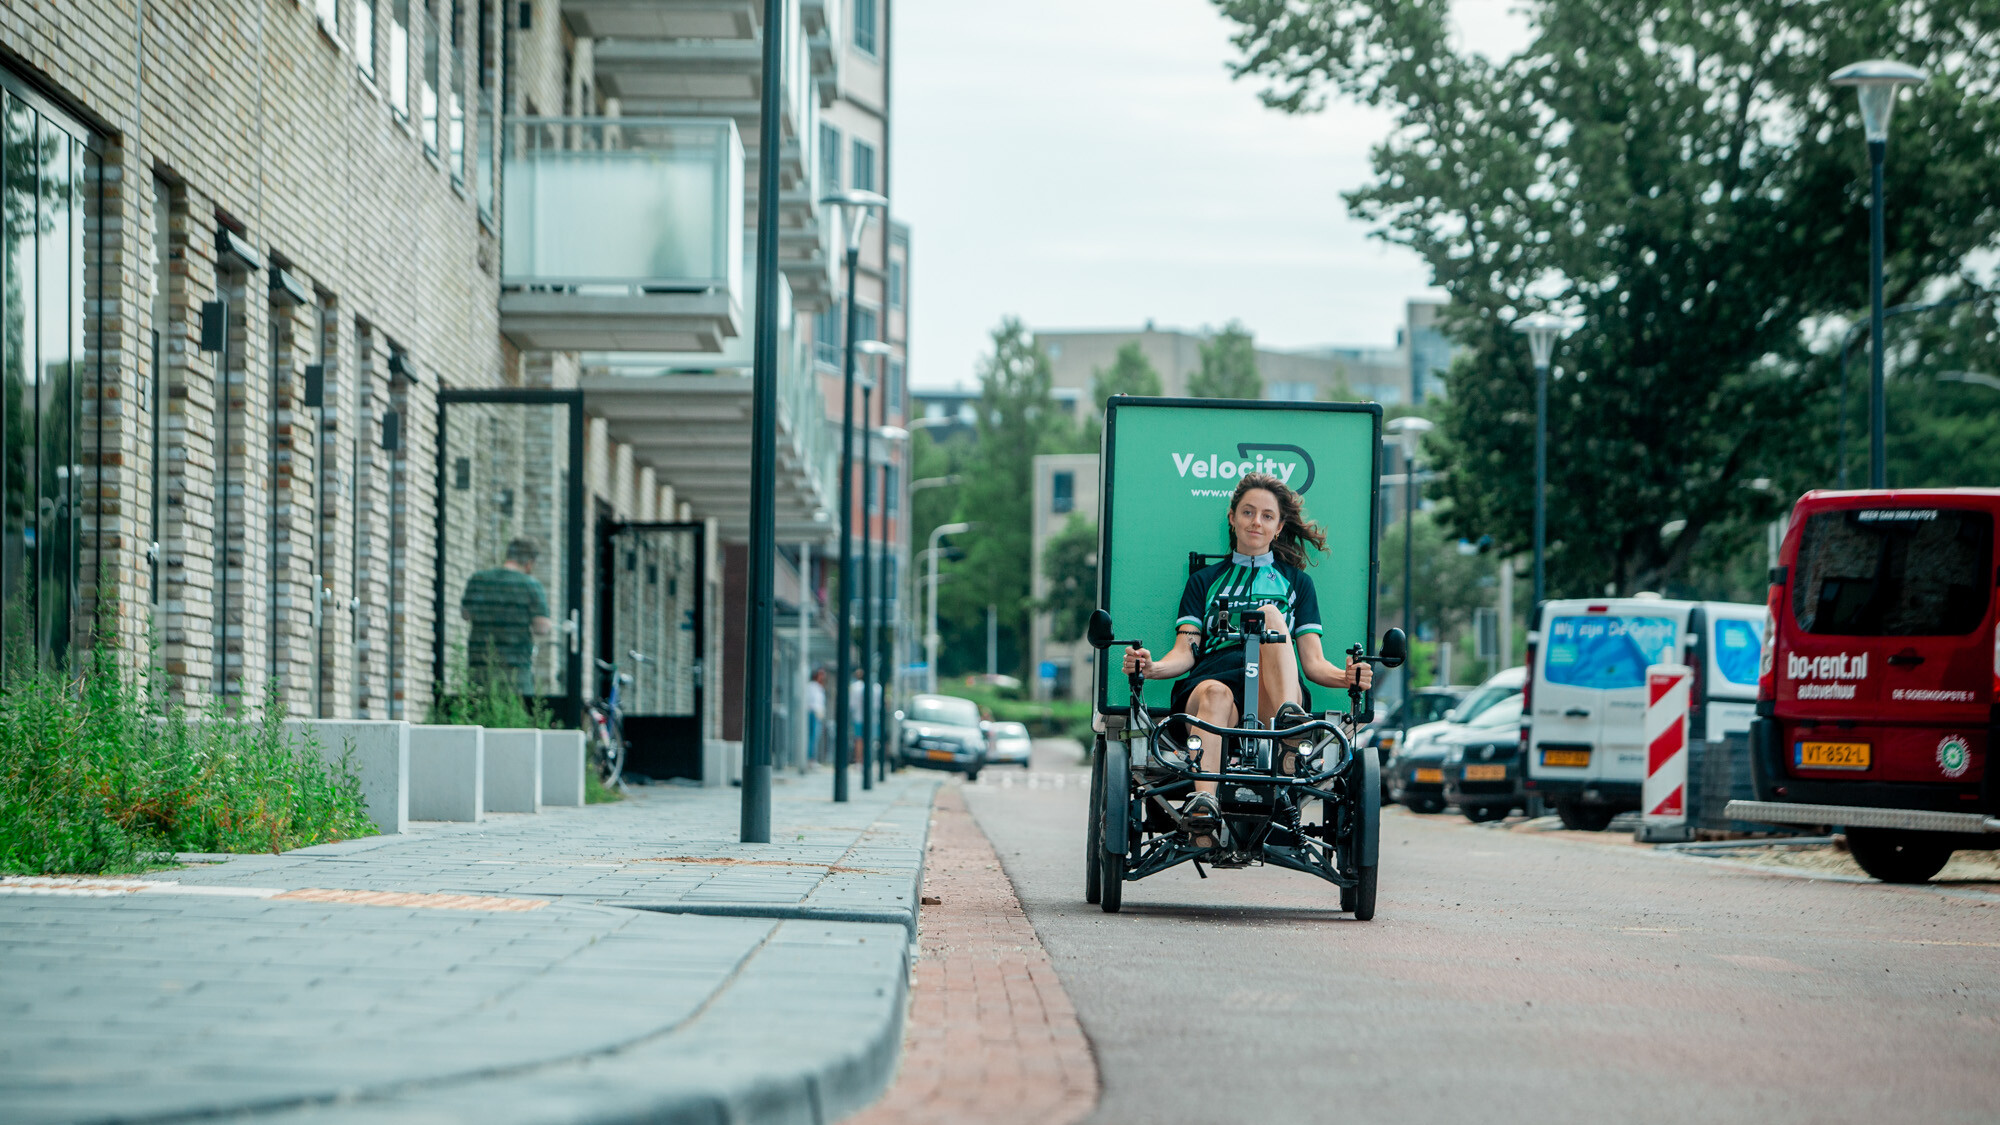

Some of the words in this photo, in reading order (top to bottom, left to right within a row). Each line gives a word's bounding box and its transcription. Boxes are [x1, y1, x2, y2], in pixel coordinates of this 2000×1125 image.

[1171, 453, 1297, 484] Velocity
[1191, 488, 1238, 498] www.ve
[1245, 662, 1259, 678] 5
[1787, 651, 1868, 679] bo-rent.nl
[1797, 681, 1856, 700] autoverhuur
[1892, 689, 1905, 700] DE
[1806, 745, 1864, 763] VT-852-L
